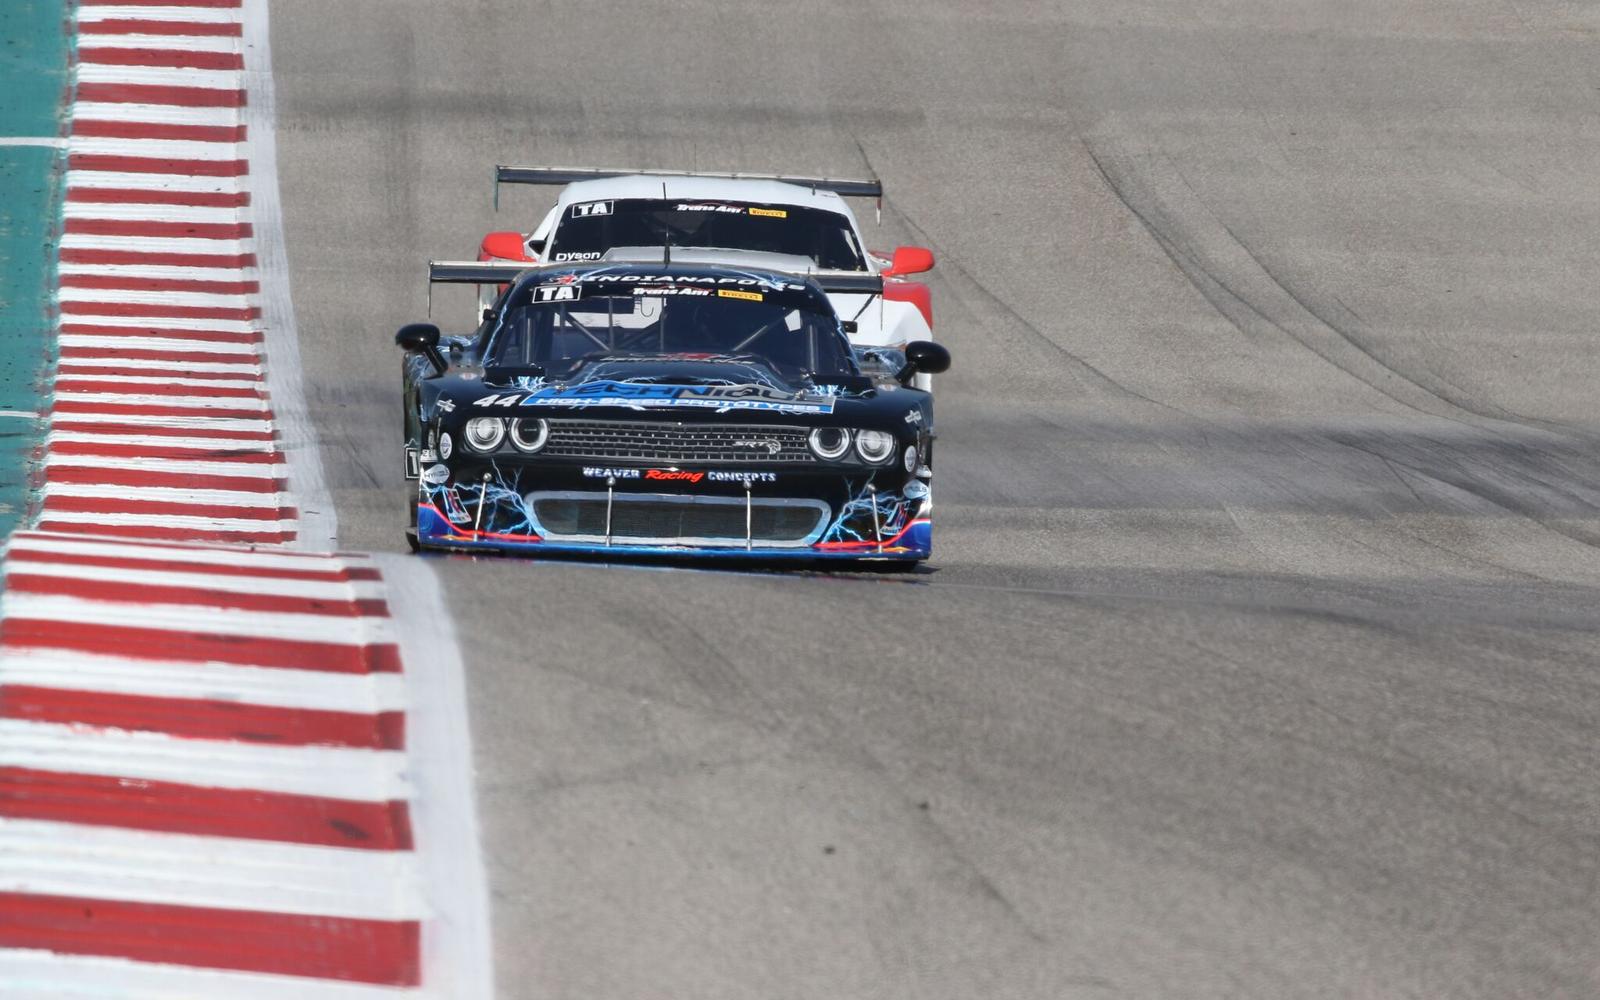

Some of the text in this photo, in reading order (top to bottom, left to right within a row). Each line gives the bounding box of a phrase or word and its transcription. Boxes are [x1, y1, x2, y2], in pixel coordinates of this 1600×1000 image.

[578, 203, 608, 215] TA
[556, 252, 601, 262] Dyson
[541, 287, 574, 301] TA
[633, 287, 677, 296] Trans
[553, 383, 824, 402] ECHNIQU
[472, 394, 522, 408] 44
[673, 399, 820, 411] PROTOTYPES
[582, 467, 777, 483] WEAVER Racing CONCEPTS
